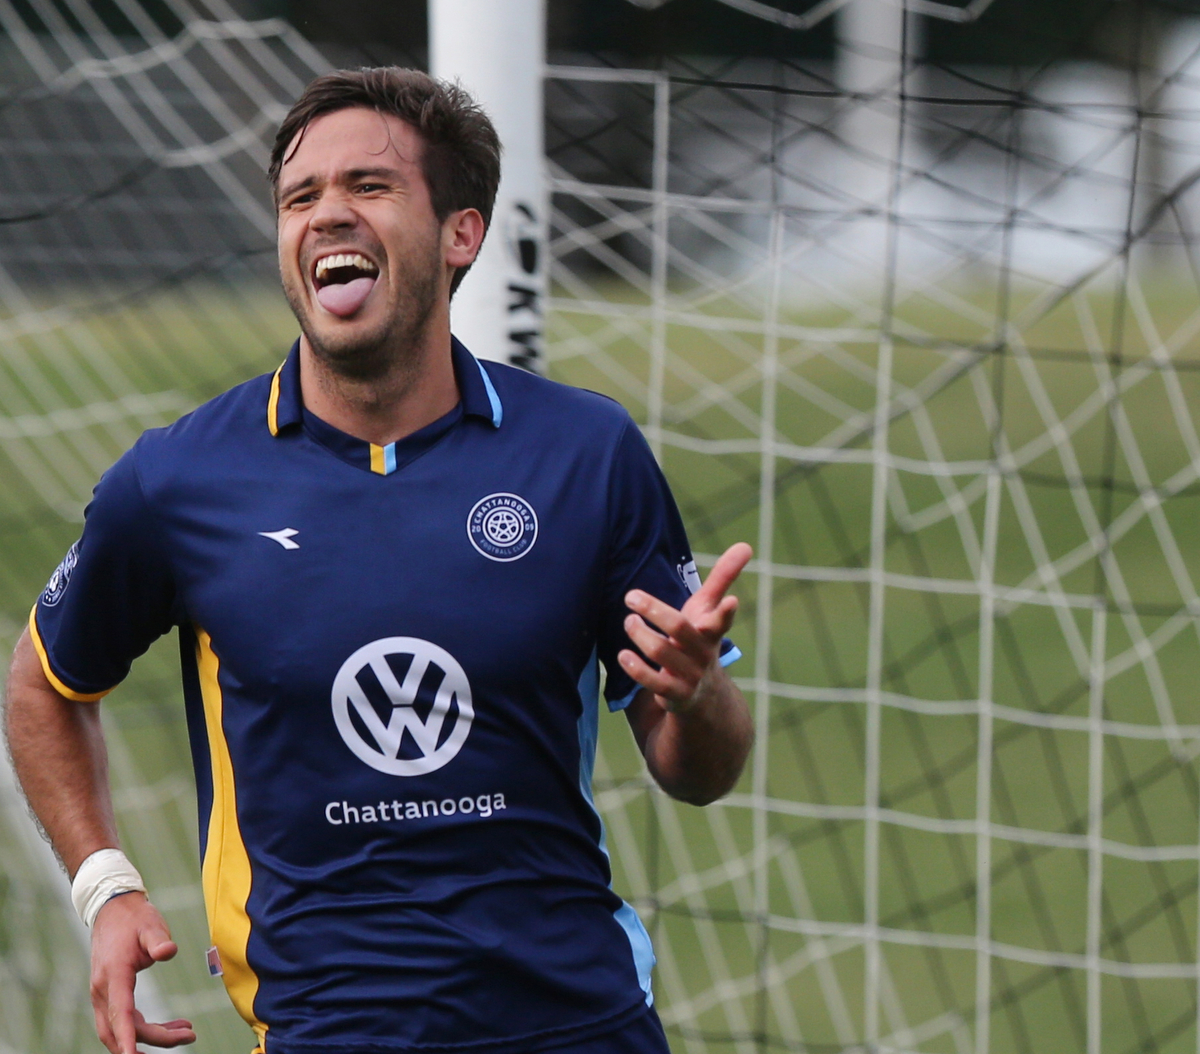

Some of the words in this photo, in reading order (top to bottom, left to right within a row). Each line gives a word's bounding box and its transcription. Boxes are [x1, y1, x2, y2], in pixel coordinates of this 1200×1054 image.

[474, 498, 531, 524] CHATTANOOGA
[471, 525, 482, 534] 20
[480, 538, 512, 555] FOOTBALL
[513, 538, 528, 551] CLUB
[331, 636, 475, 777] VW
[325, 792, 507, 826] Chattanooga
